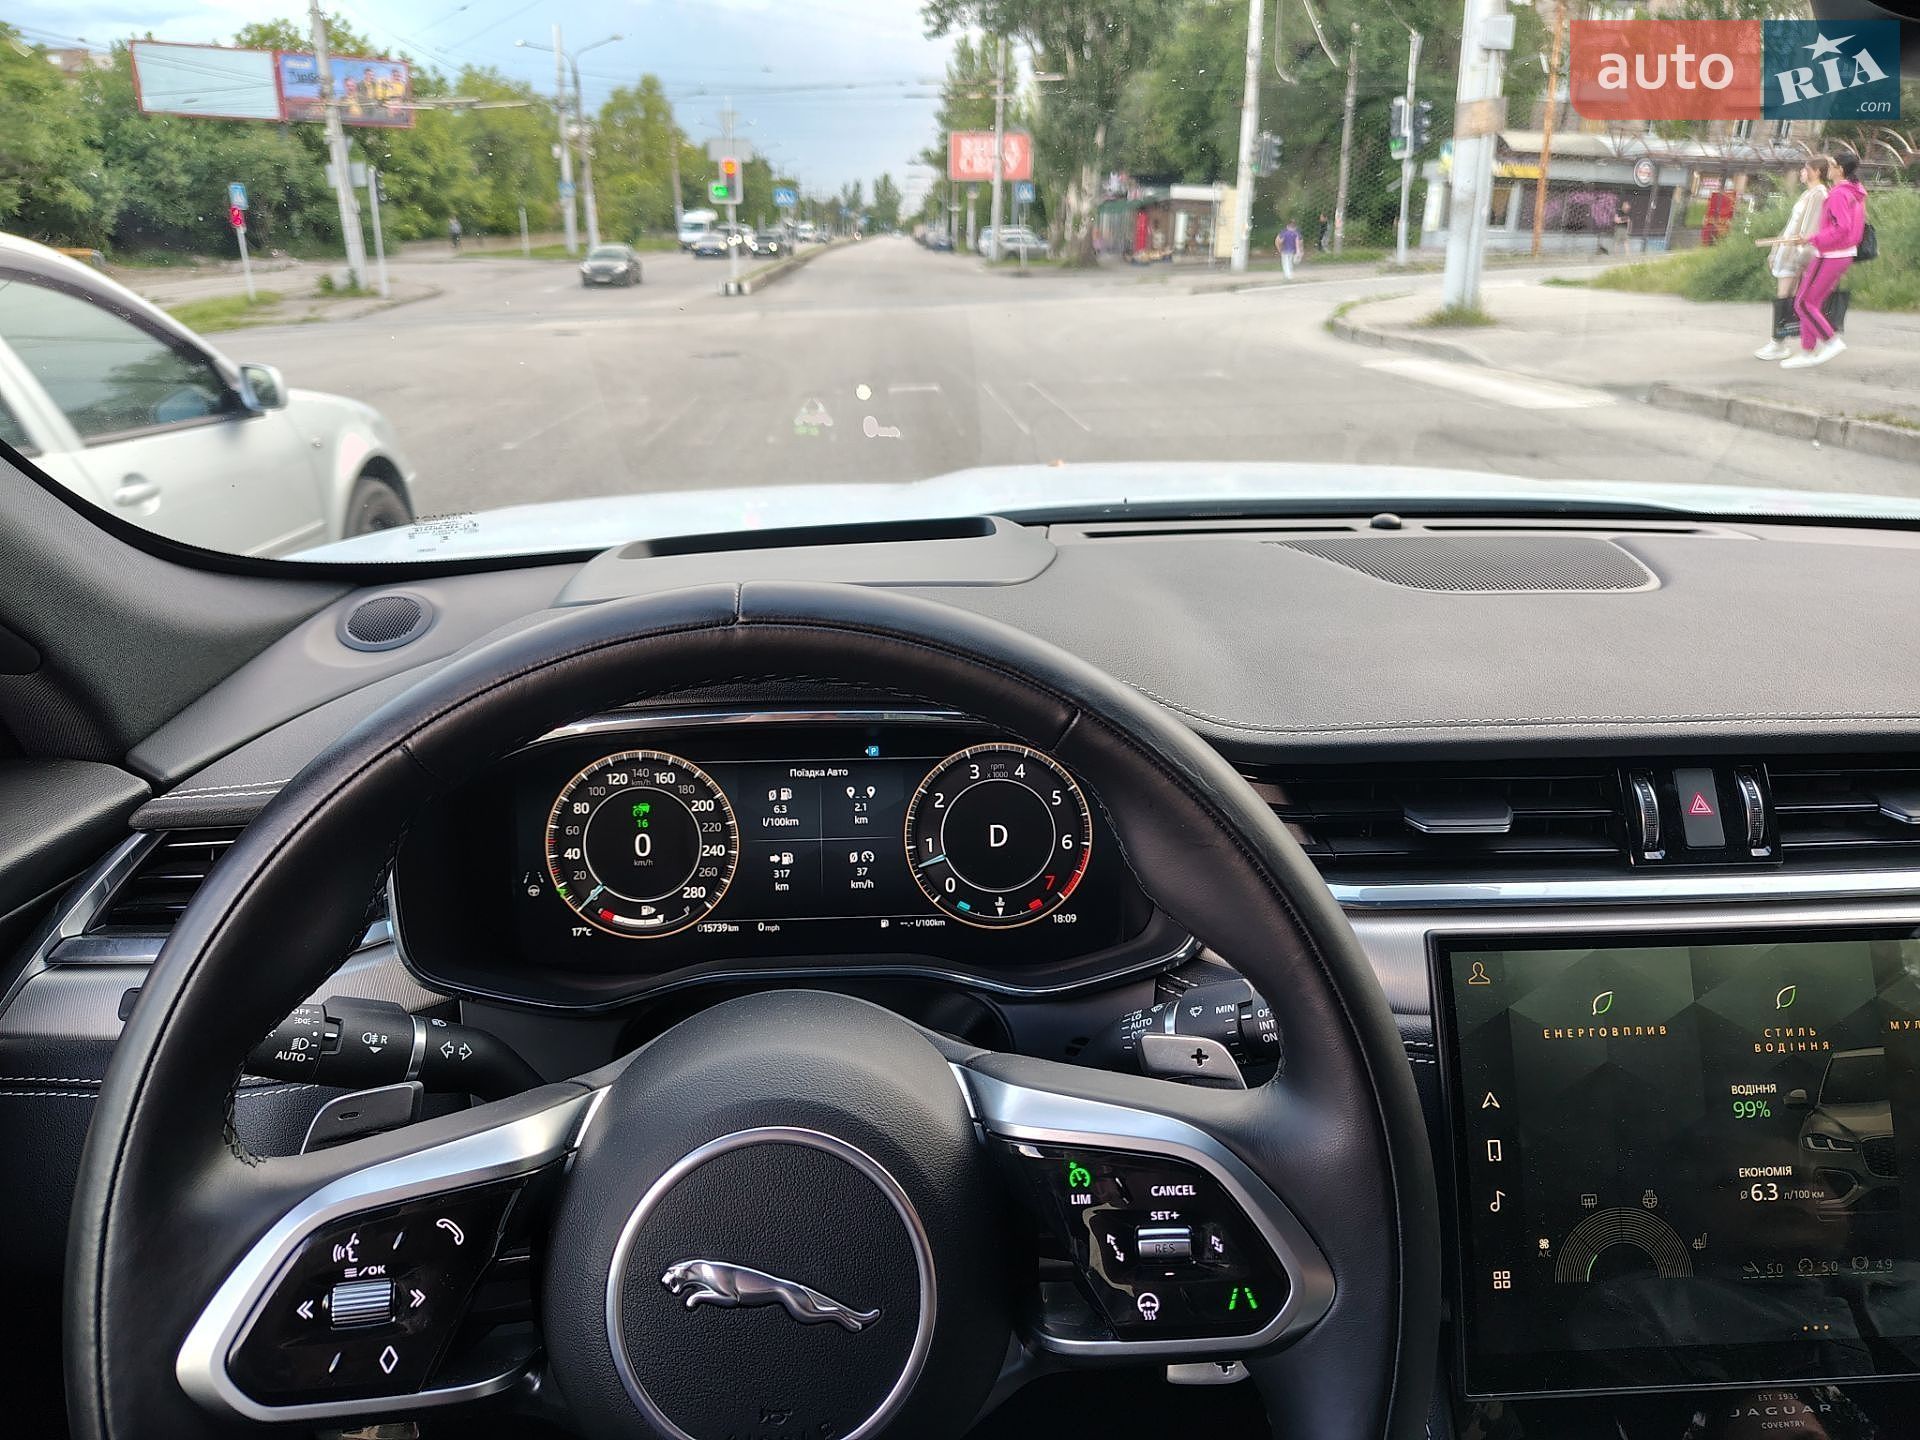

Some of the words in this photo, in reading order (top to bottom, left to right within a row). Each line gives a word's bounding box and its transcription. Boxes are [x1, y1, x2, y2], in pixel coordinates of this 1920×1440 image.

[631, 768, 650, 778] 140
[789, 768, 826, 778] Поїздка
[826, 768, 849, 777] Авто
[969, 764, 980, 779] 3
[990, 763, 1005, 771] rpm
[1014, 763, 1026, 779] 4
[606, 773, 628, 786] 120
[631, 778, 651, 787] km/h
[654, 772, 676, 784] 160
[588, 786, 606, 797] 100
[678, 784, 696, 795] 180
[933, 792, 945, 808] 2
[1051, 790, 1062, 806] 5
[573, 802, 590, 815] 80
[691, 800, 715, 812] 200
[773, 804, 788, 814] 6.3
[854, 802, 867, 812] 2.1
[636, 819, 649, 829] 16
[854, 815, 869, 824] km
[565, 825, 580, 836] 60
[702, 822, 722, 833] 220
[989, 824, 1009, 848] D
[1061, 834, 1073, 850] 6
[634, 833, 651, 857] 0
[702, 845, 726, 857] 240
[925, 837, 934, 853] 1
[563, 848, 581, 860] 40
[633, 858, 654, 867] km/h
[573, 870, 587, 881] 20
[698, 867, 718, 878] 260
[773, 869, 790, 878] 317
[856, 867, 868, 876] 37
[775, 881, 789, 891] km
[850, 879, 875, 889] km/h
[945, 876, 956, 893] 0
[1045, 875, 1056, 890] 7
[682, 886, 707, 899] 280
[1052, 914, 1077, 924] 18:09
[765, 924, 780, 932] mph
[1215, 1003, 1236, 1015] MIN
[1131, 1013, 1142, 1021] LO
[1130, 1017, 1153, 1030] AUTO
[1259, 1019, 1275, 1031] INT
[1262, 1032, 1278, 1043] ON
[1543, 1025, 1668, 1039] ЕНЕРГОВПЛИВ
[1764, 1027, 1817, 1038] СТИЛЬ
[1754, 1041, 1830, 1054] ВОДІННЯ
[274, 1050, 306, 1062] AUTO
[1731, 1083, 1777, 1096] ВОДІННЯ
[1733, 1100, 1771, 1119] 99%
[1738, 1165, 1793, 1178] ЕКОНОМІЯ
[1150, 1184, 1197, 1196] CANCEL
[1750, 1182, 1779, 1201] 6.3
[1783, 1189, 1810, 1200] л/100
[1812, 1191, 1825, 1199] км
[1070, 1194, 1092, 1205] LIM
[1150, 1211, 1180, 1221] SET+
[1155, 1243, 1177, 1255] RES
[1729, 1403, 1833, 1418] JAGUAR
[1761, 1420, 1805, 1429] COVENTRY
